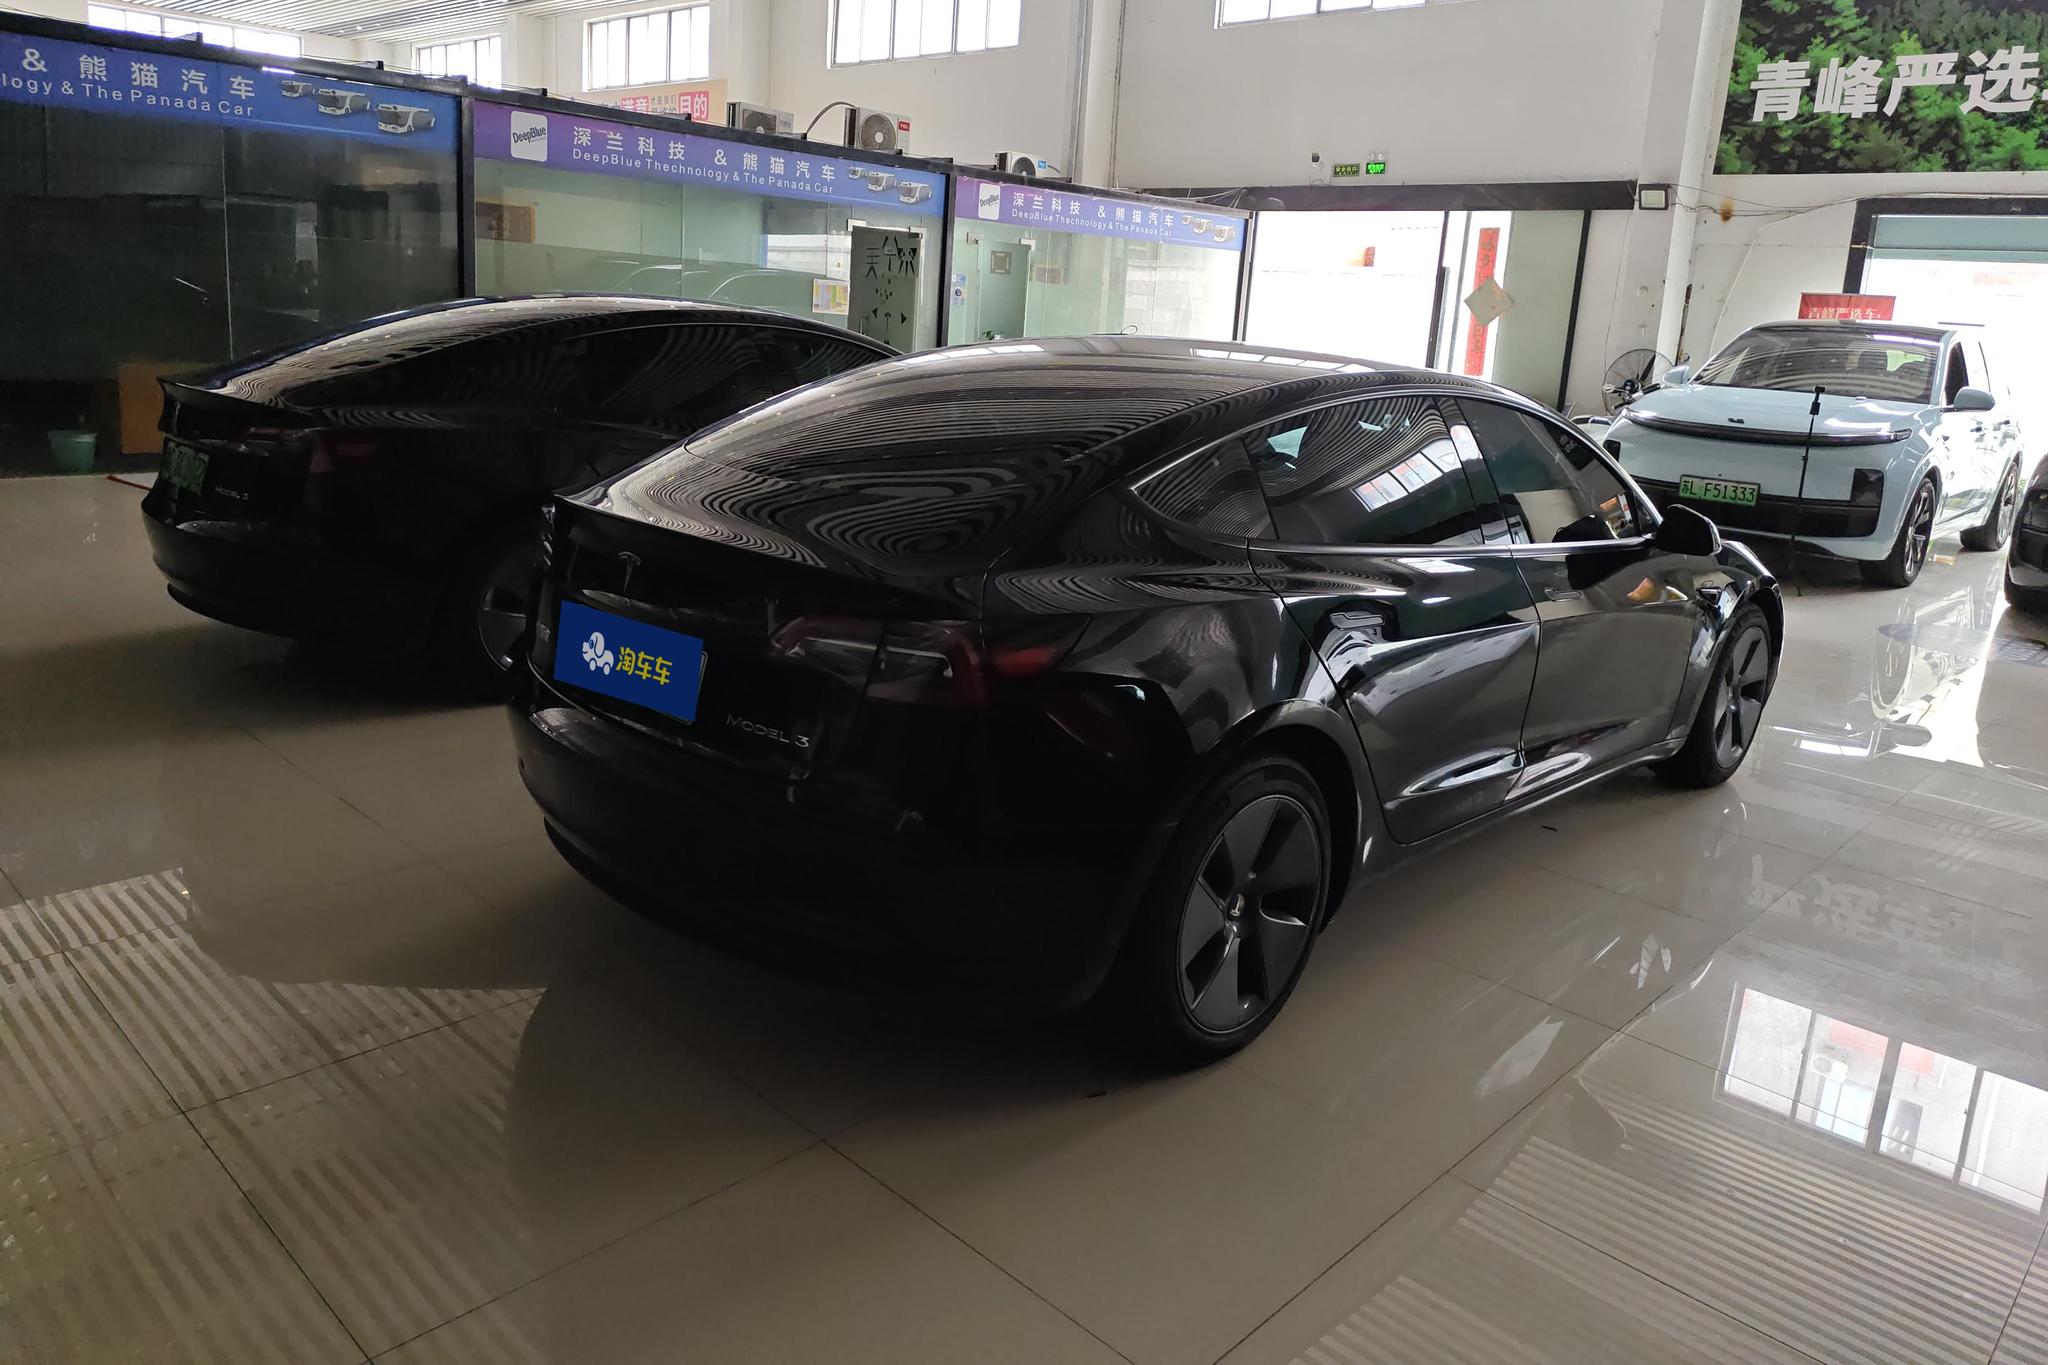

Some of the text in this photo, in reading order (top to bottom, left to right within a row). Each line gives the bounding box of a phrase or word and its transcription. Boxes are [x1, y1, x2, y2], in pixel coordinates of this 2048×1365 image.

[22, 48, 255, 100] & 熊猫汽车
[1750, 45, 2048, 122] 青峰严选
[62, 80, 74, 95] &
[81, 83, 122, 100] The
[131, 89, 211, 112] Panada
[218, 101, 254, 117] Car
[680, 93, 708, 119] 目的
[512, 126, 547, 144] DeepBlue
[572, 148, 833, 194] DeepBlue Thechnology & The Panada Car
[573, 126, 836, 182] 深兰科技 & 熊猫汽车
[1011, 208, 1054, 222] DeepBlue
[1115, 222, 1129, 232] The
[1013, 191, 1174, 228] 深兰科技 & 熊猫汽车
[1703, 482, 1756, 503] F51333
[726, 712, 810, 748] MODEL 3
